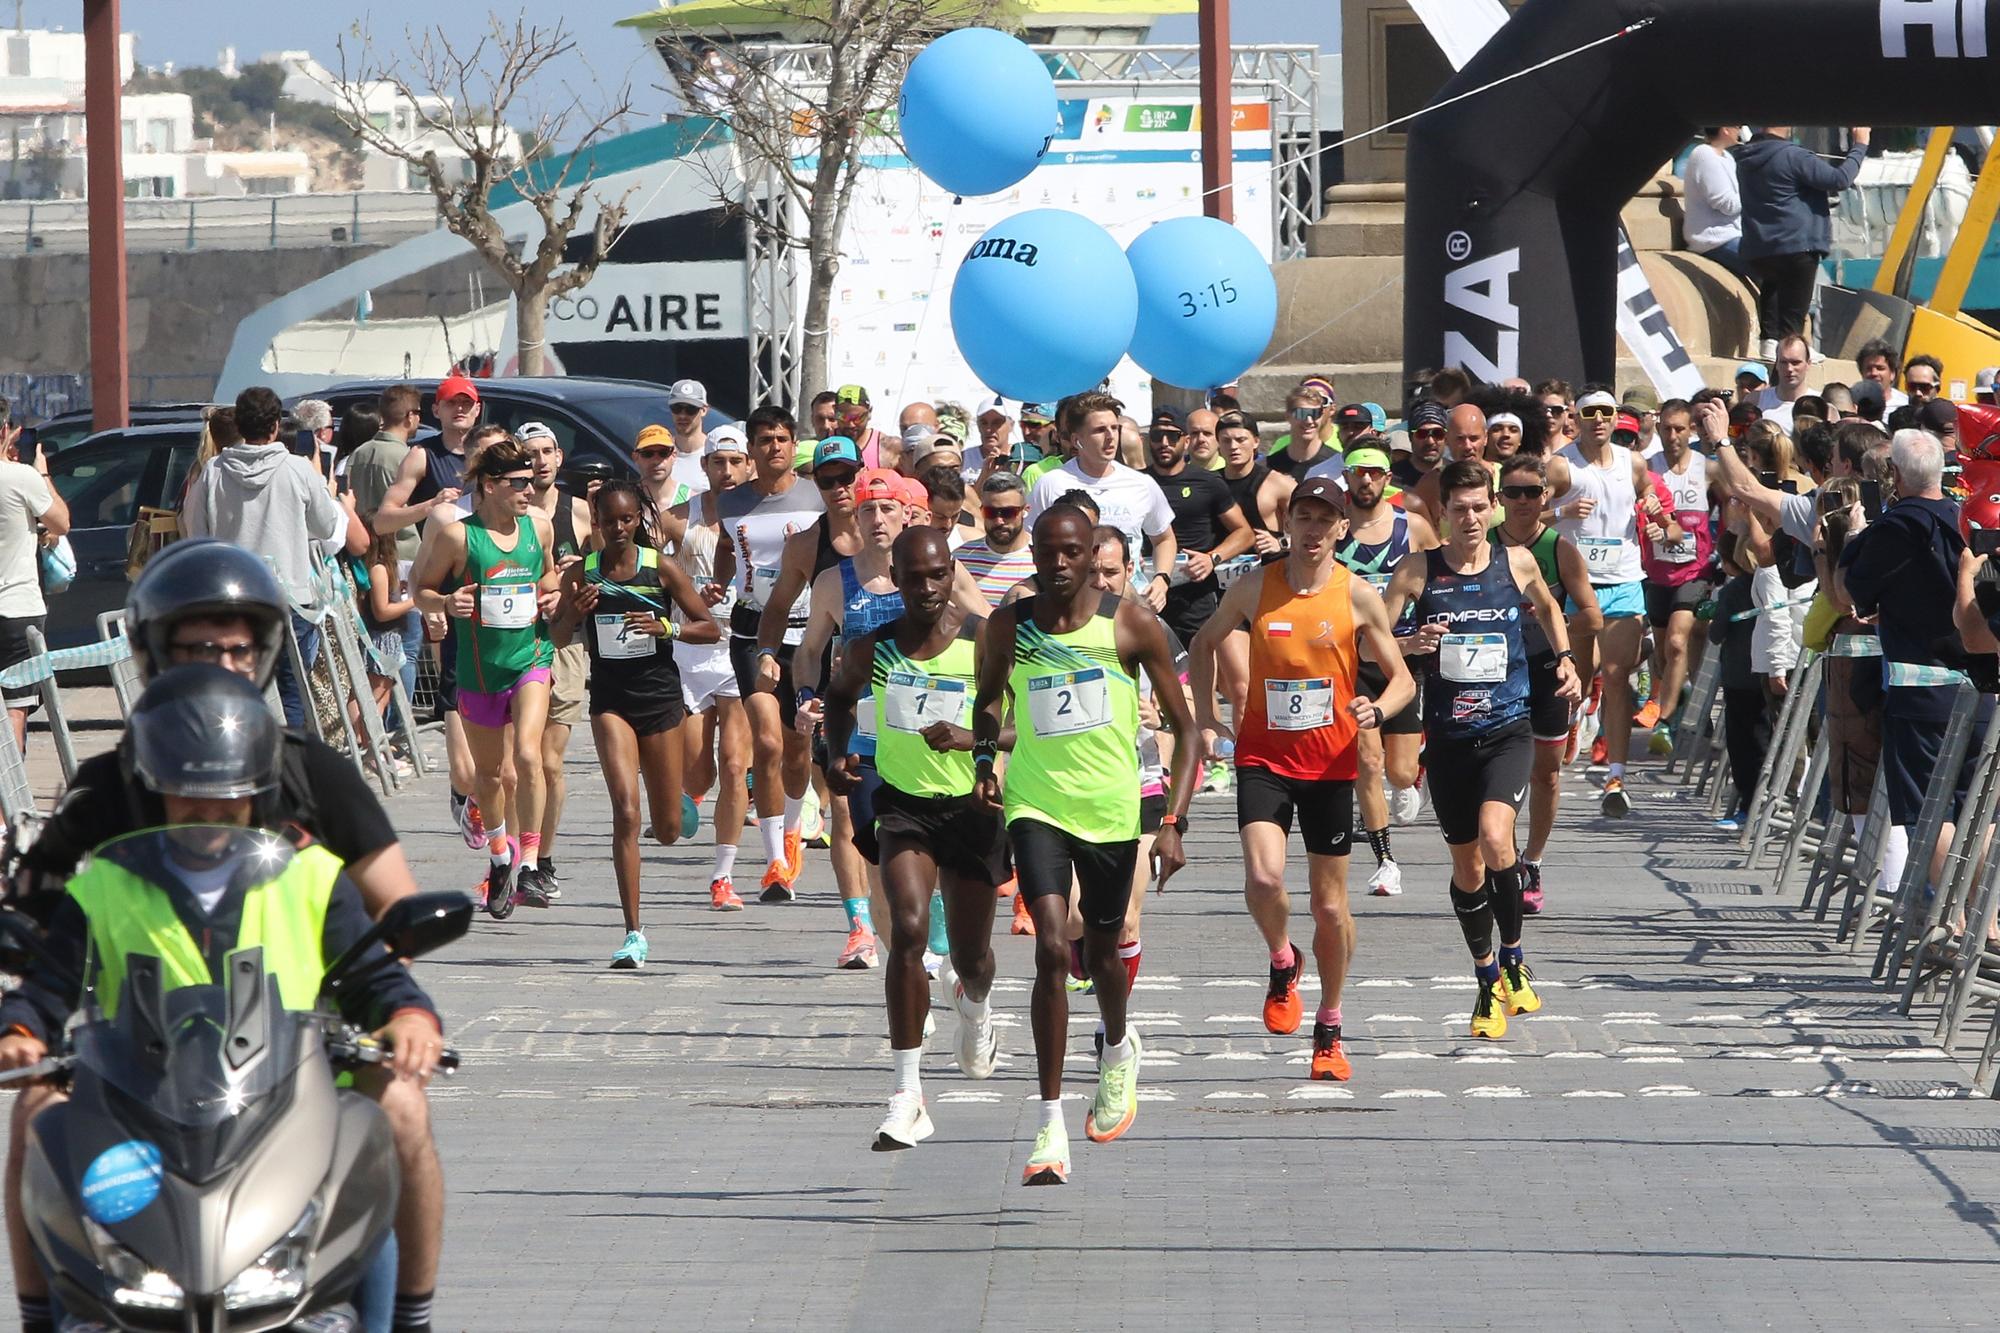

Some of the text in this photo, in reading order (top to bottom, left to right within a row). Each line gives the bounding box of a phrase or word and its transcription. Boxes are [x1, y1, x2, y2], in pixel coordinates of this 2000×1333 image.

[1178, 278, 1237, 318] 3:15
[604, 293, 722, 333] AIRE
[1589, 547, 1608, 562] 81
[503, 598, 514, 615] 9
[1426, 608, 1507, 625] COMPEX
[615, 624, 628, 644] 4
[1466, 648, 1479, 667] 7
[915, 693, 929, 715] 1
[1056, 690, 1073, 716] 2
[1289, 694, 1303, 715] 8
